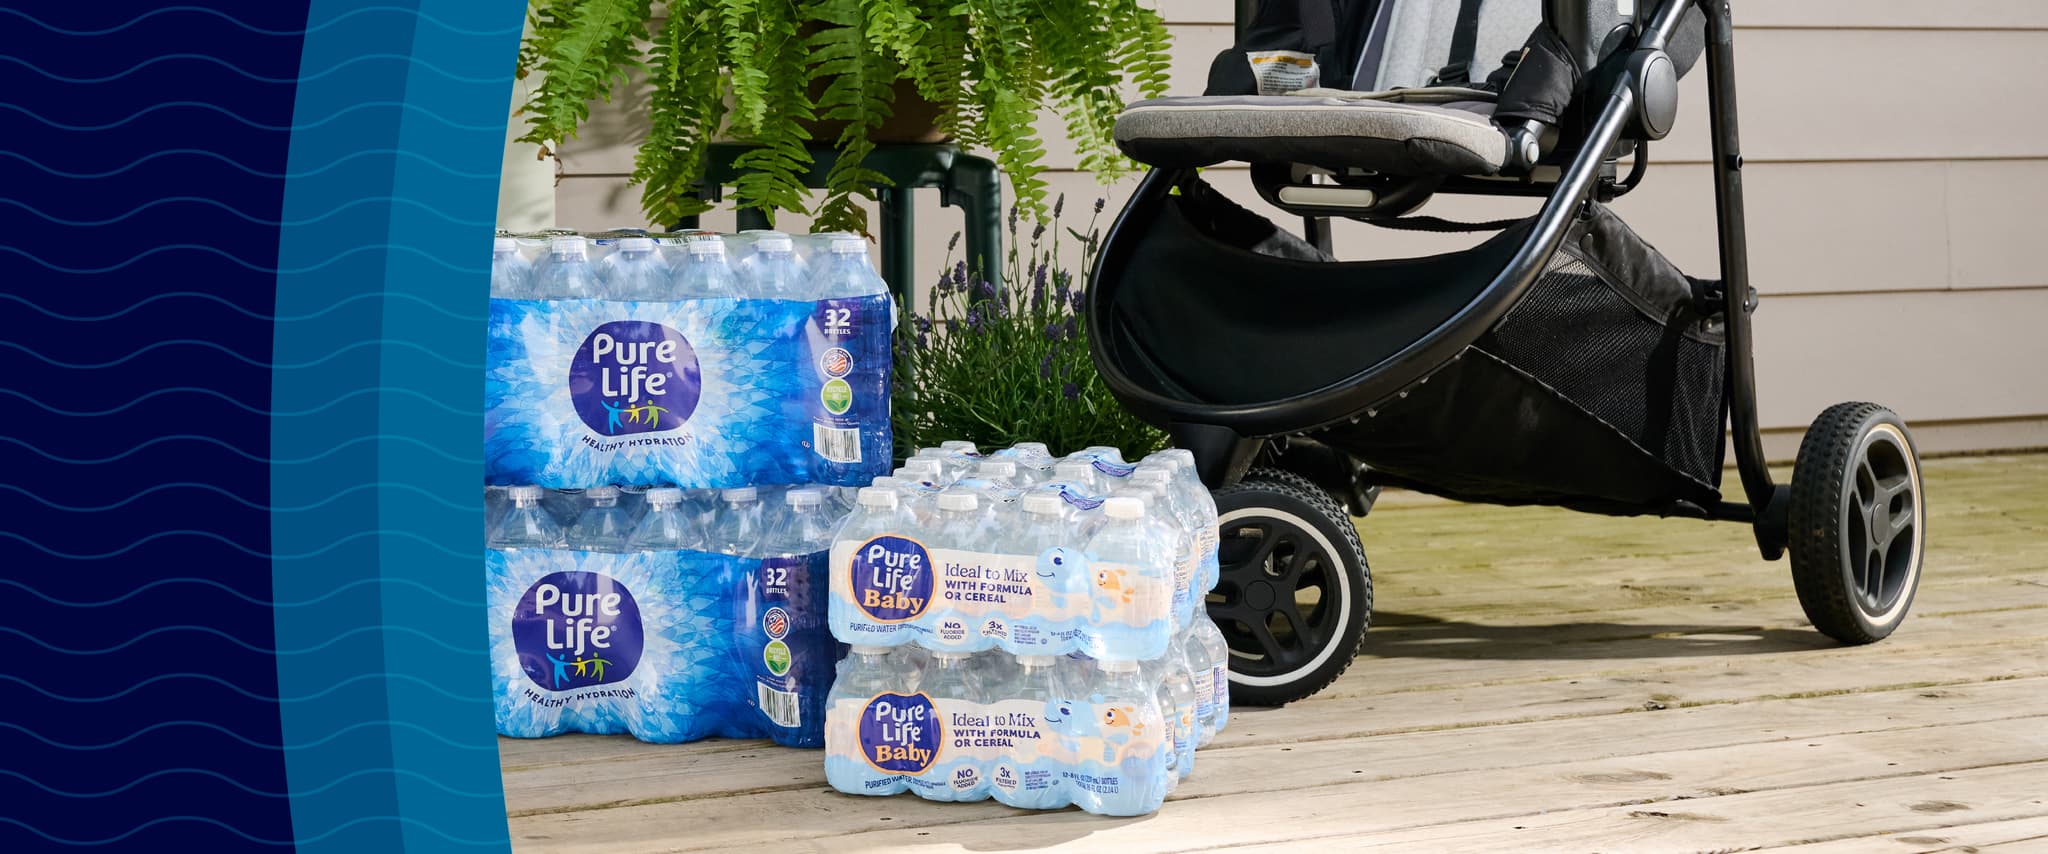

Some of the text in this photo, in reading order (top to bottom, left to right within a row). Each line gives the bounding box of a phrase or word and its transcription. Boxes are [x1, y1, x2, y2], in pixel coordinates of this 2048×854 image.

[824, 308, 851, 327] 32
[593, 333, 677, 365] Pure
[581, 431, 694, 453] HEALTHY HYDRATION
[867, 544, 921, 570] Pure
[766, 567, 787, 586] 32
[872, 565, 914, 595] Life
[945, 563, 1028, 583] Ideal to Mix
[944, 591, 1007, 604] OR CEREAL
[945, 580, 1033, 596] WITH FORMULA
[535, 583, 621, 617] Pure
[863, 588, 924, 615] Baby
[876, 623, 897, 633] WATER
[944, 621, 961, 629] NO
[988, 620, 1003, 630] 3x
[524, 687, 636, 708] HEALTHY HYDRATION
[875, 701, 925, 723] Pure
[952, 712, 1036, 728] Ideal to Mix
[882, 721, 921, 747] Life
[953, 729, 1041, 740] WITH FORMULA
[954, 738, 1014, 748] OR CEREAL
[875, 743, 932, 768] Baby
[957, 768, 973, 779] NO
[999, 767, 1011, 779] 3x
[864, 777, 892, 789] PURIFIED
